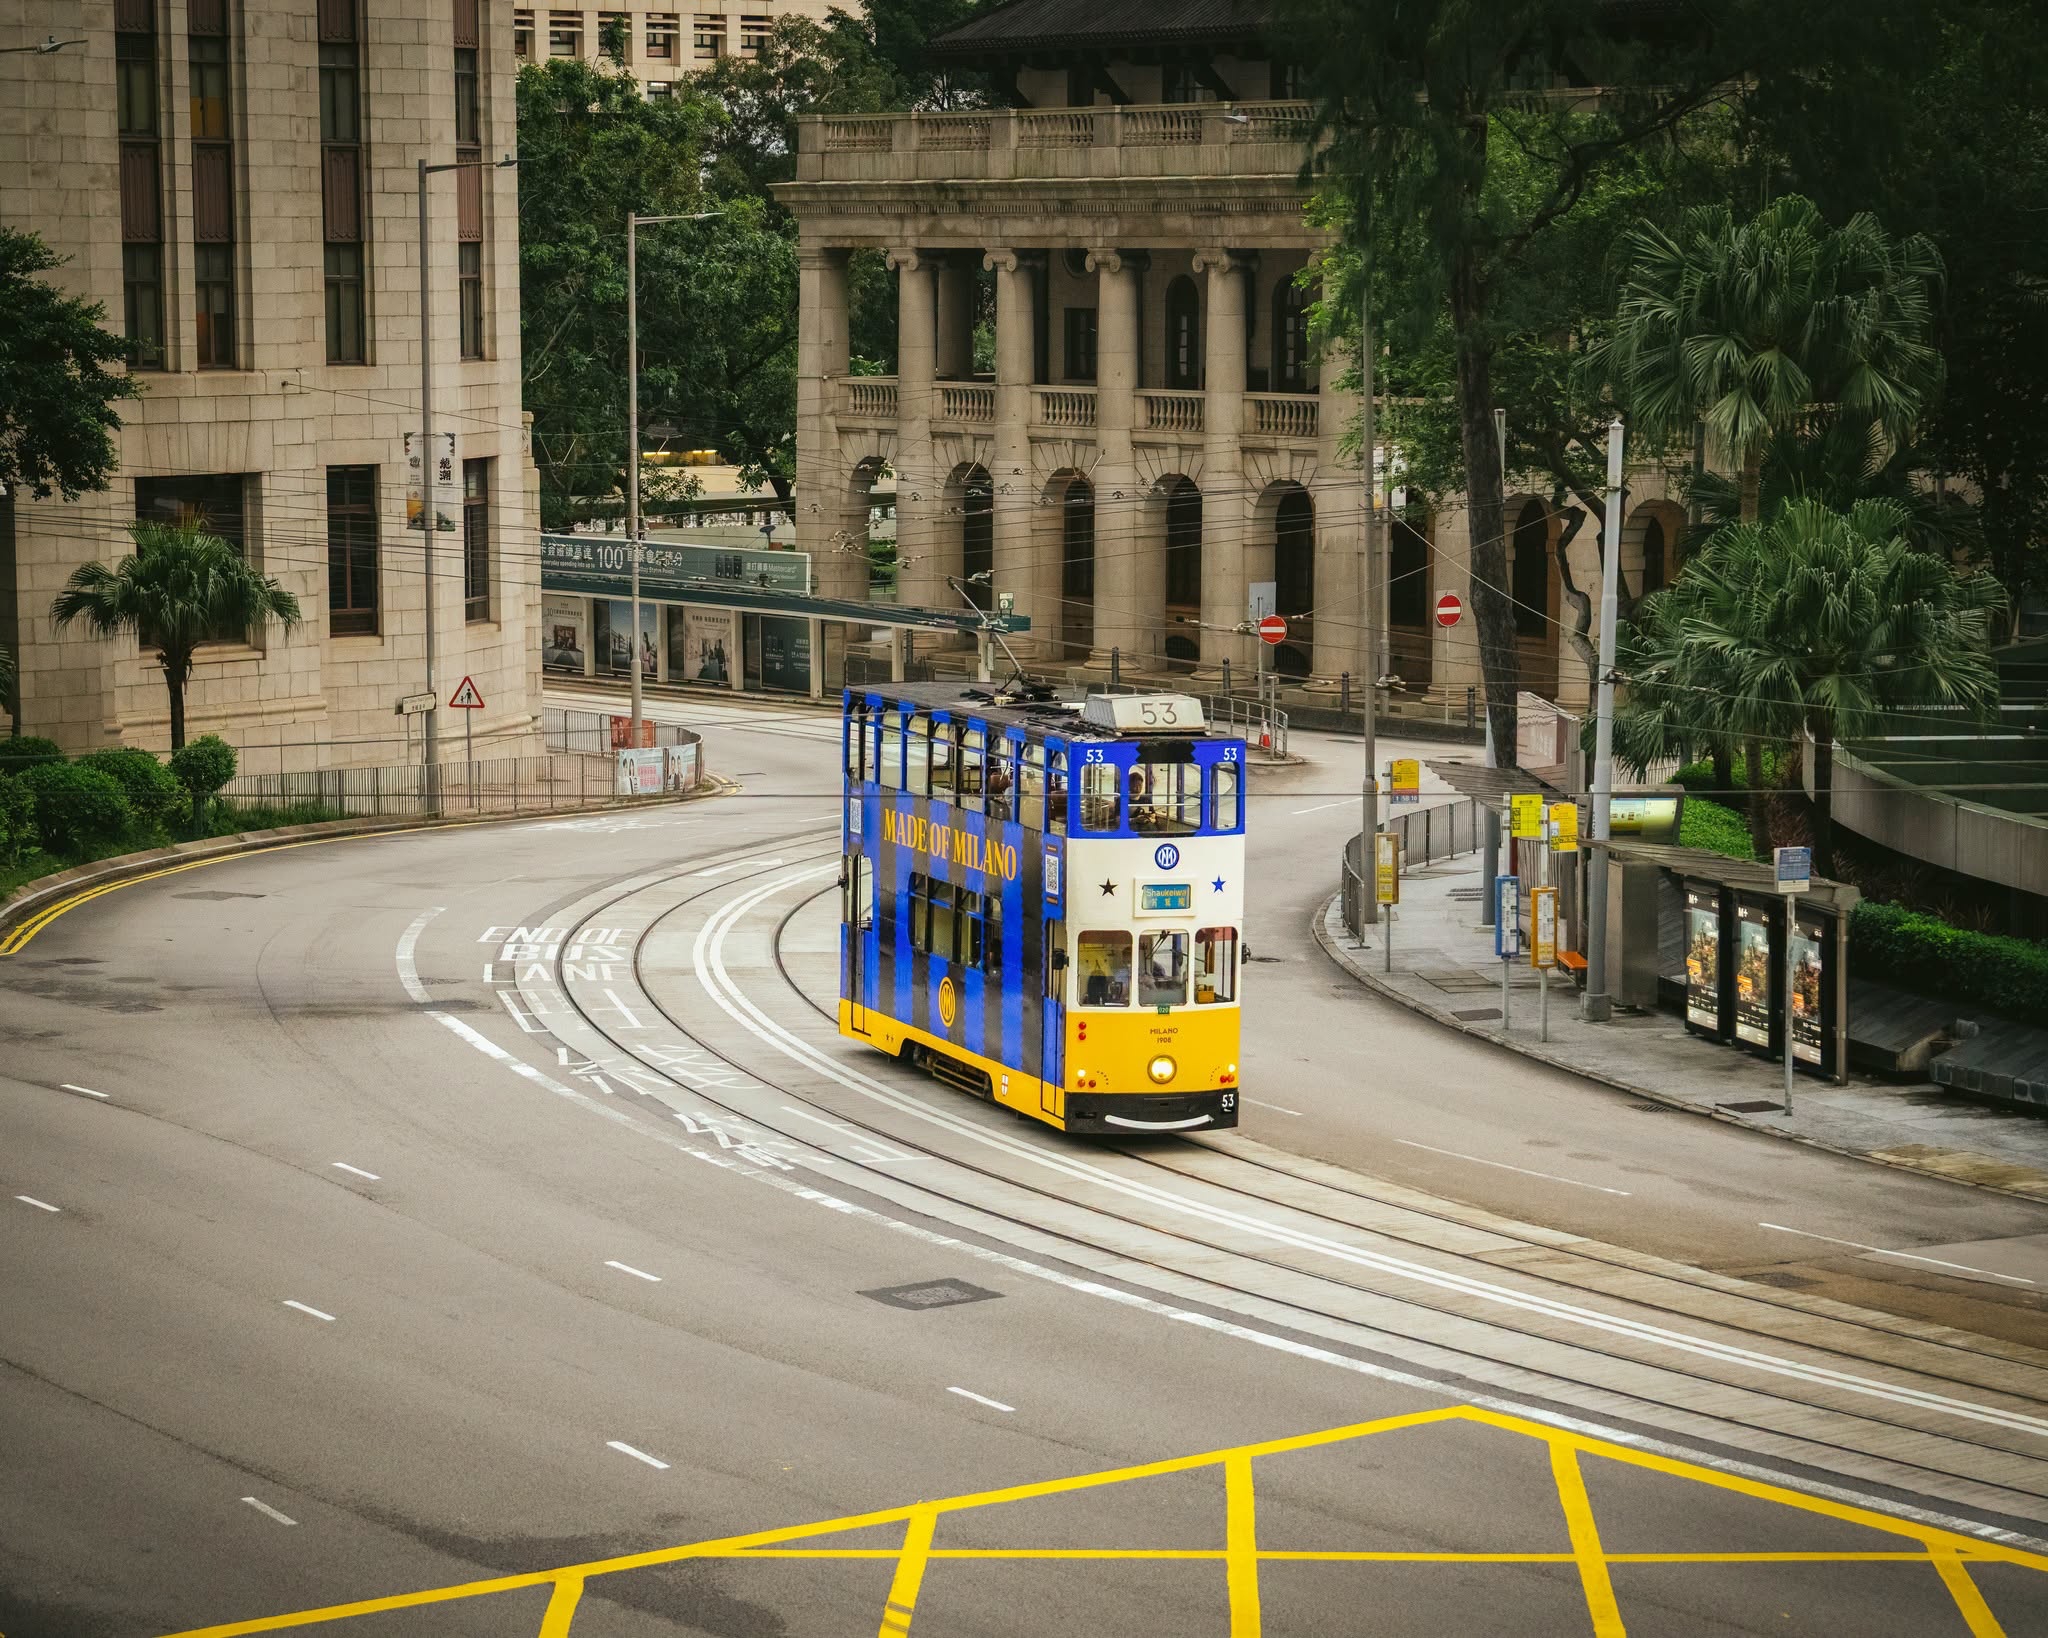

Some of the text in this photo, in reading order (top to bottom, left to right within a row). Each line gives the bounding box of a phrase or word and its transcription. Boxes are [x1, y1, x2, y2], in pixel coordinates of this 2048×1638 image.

[597, 546, 623, 569] 100
[1141, 702, 1177, 725] 53
[1086, 749, 1104, 763] 53
[1223, 748, 1237, 761] 53
[884, 808, 1017, 881] MADE OF MILANO
[476, 926, 638, 945] END OF
[499, 944, 627, 961] BUS
[482, 963, 633, 982] LANE
[1221, 1093, 1234, 1107] 53
